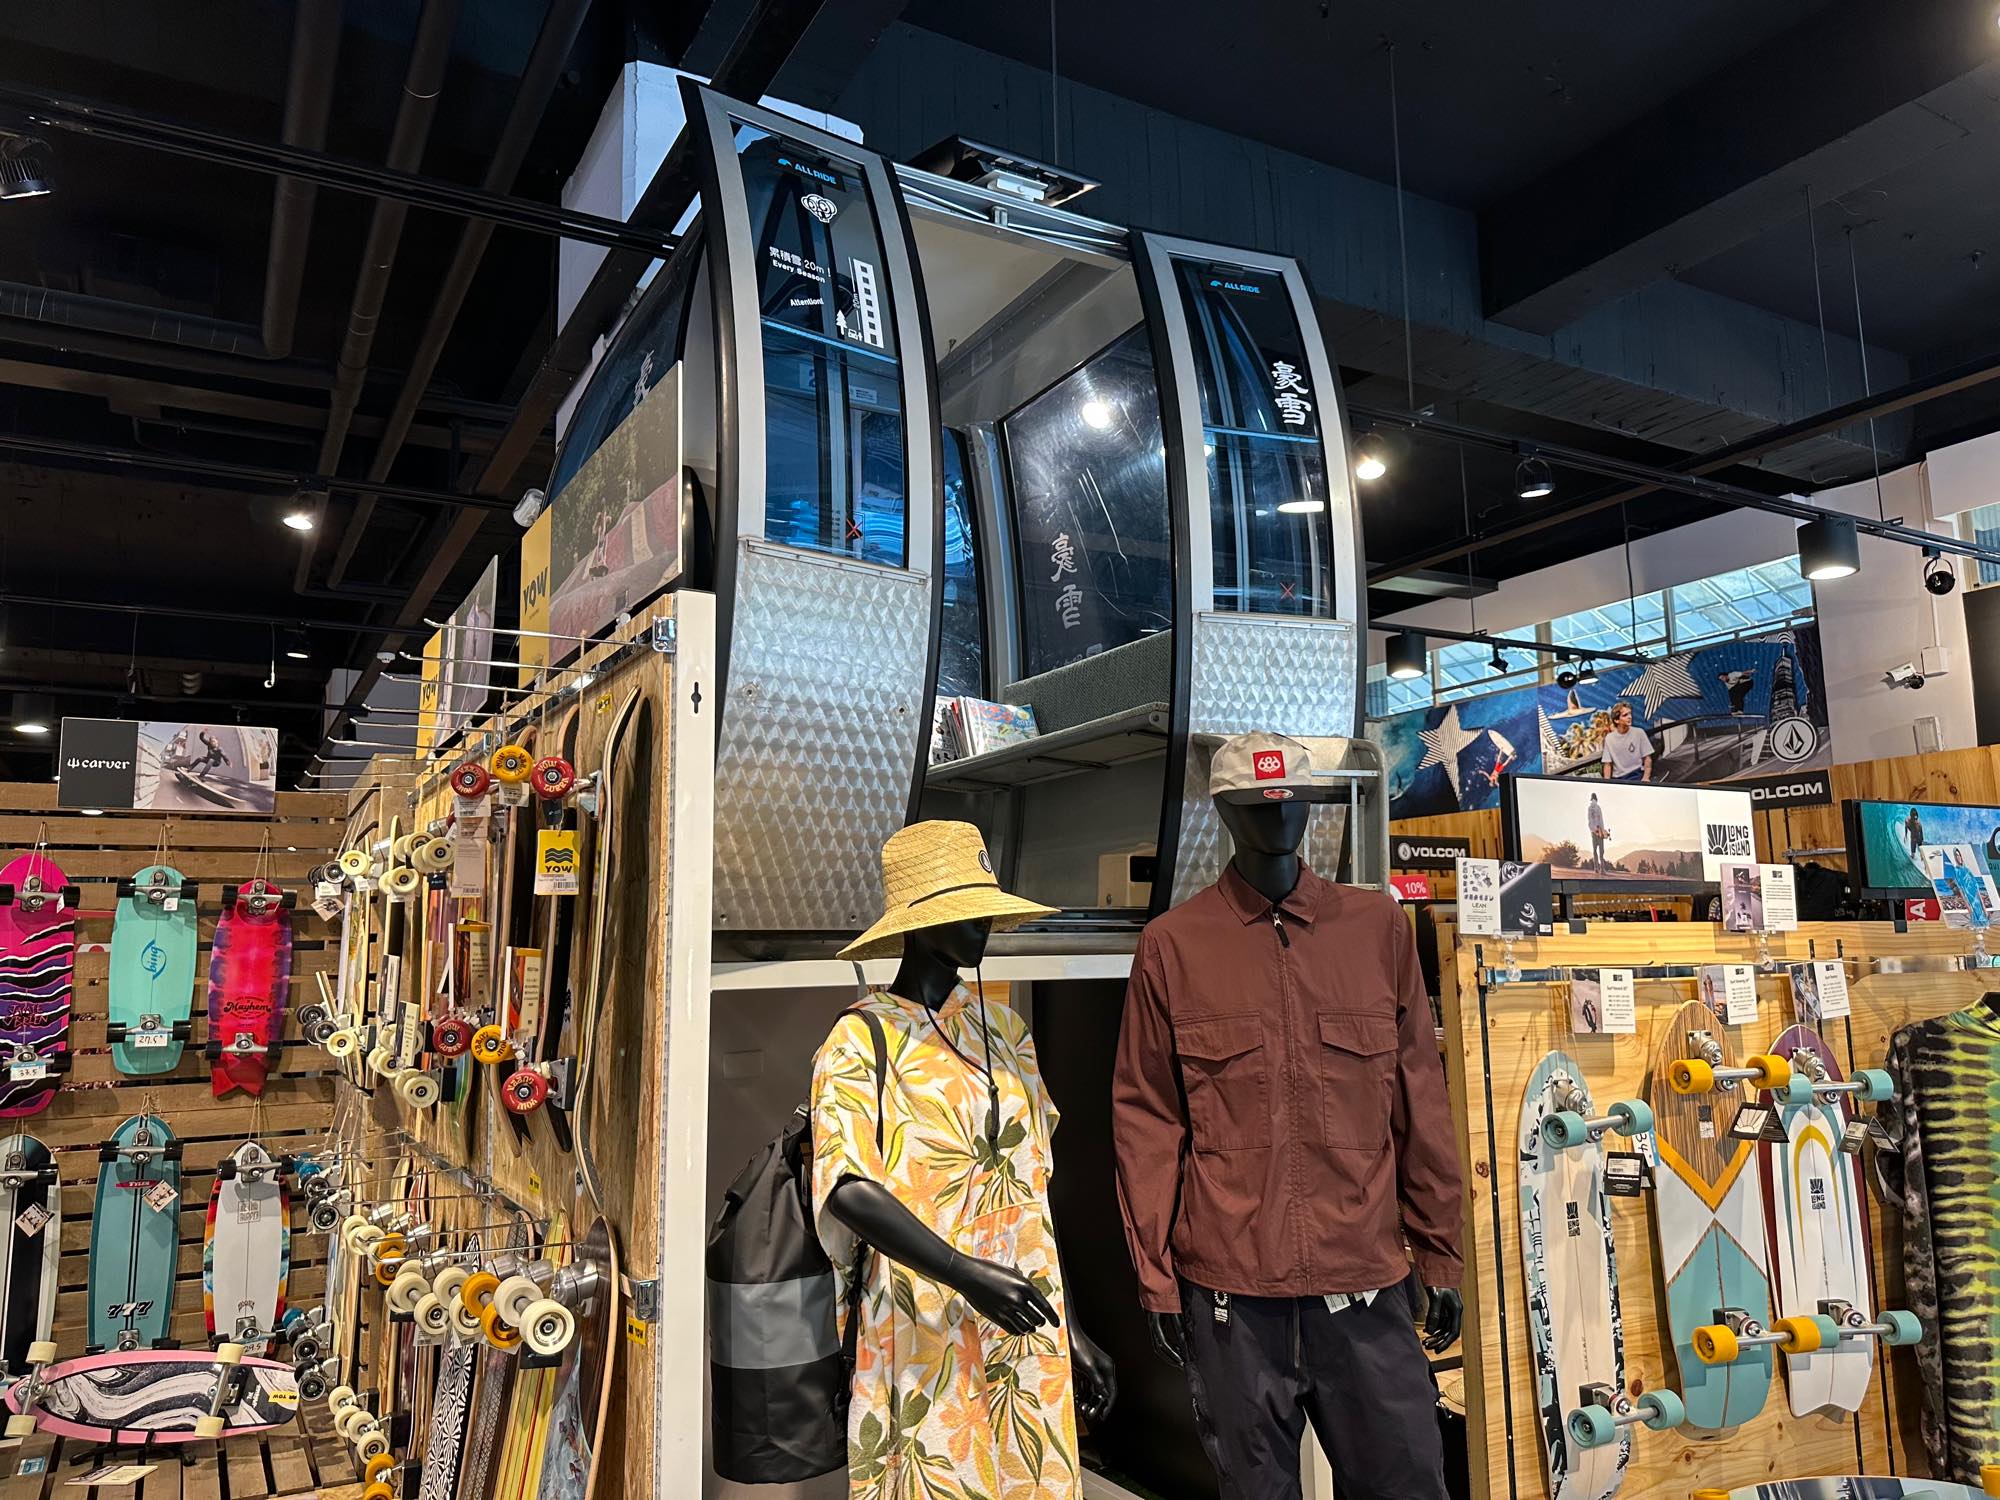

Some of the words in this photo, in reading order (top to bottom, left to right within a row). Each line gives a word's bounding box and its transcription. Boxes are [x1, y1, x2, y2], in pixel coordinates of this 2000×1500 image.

[772, 259, 795, 273] Every
[796, 268, 826, 284] Season
[804, 260, 825, 275] 20m
[1271, 360, 1312, 426] 豪雪
[523, 567, 549, 613] YOW
[422, 674, 438, 705] YOW
[81, 759, 131, 770] carver
[538, 760, 558, 772] YOW
[1257, 756, 1281, 773] 686
[1751, 781, 1824, 801] OLCOM
[1727, 824, 1749, 843] LONG
[1411, 846, 1466, 858] VOLCOM
[1729, 839, 1751, 857] ISLAND
[545, 865, 573, 873] YOW
[1405, 881, 1427, 895] 10%
[223, 1001, 272, 1013] Mayhem
[517, 1098, 539, 1110] YOW
[107, 1301, 154, 1319] 777
